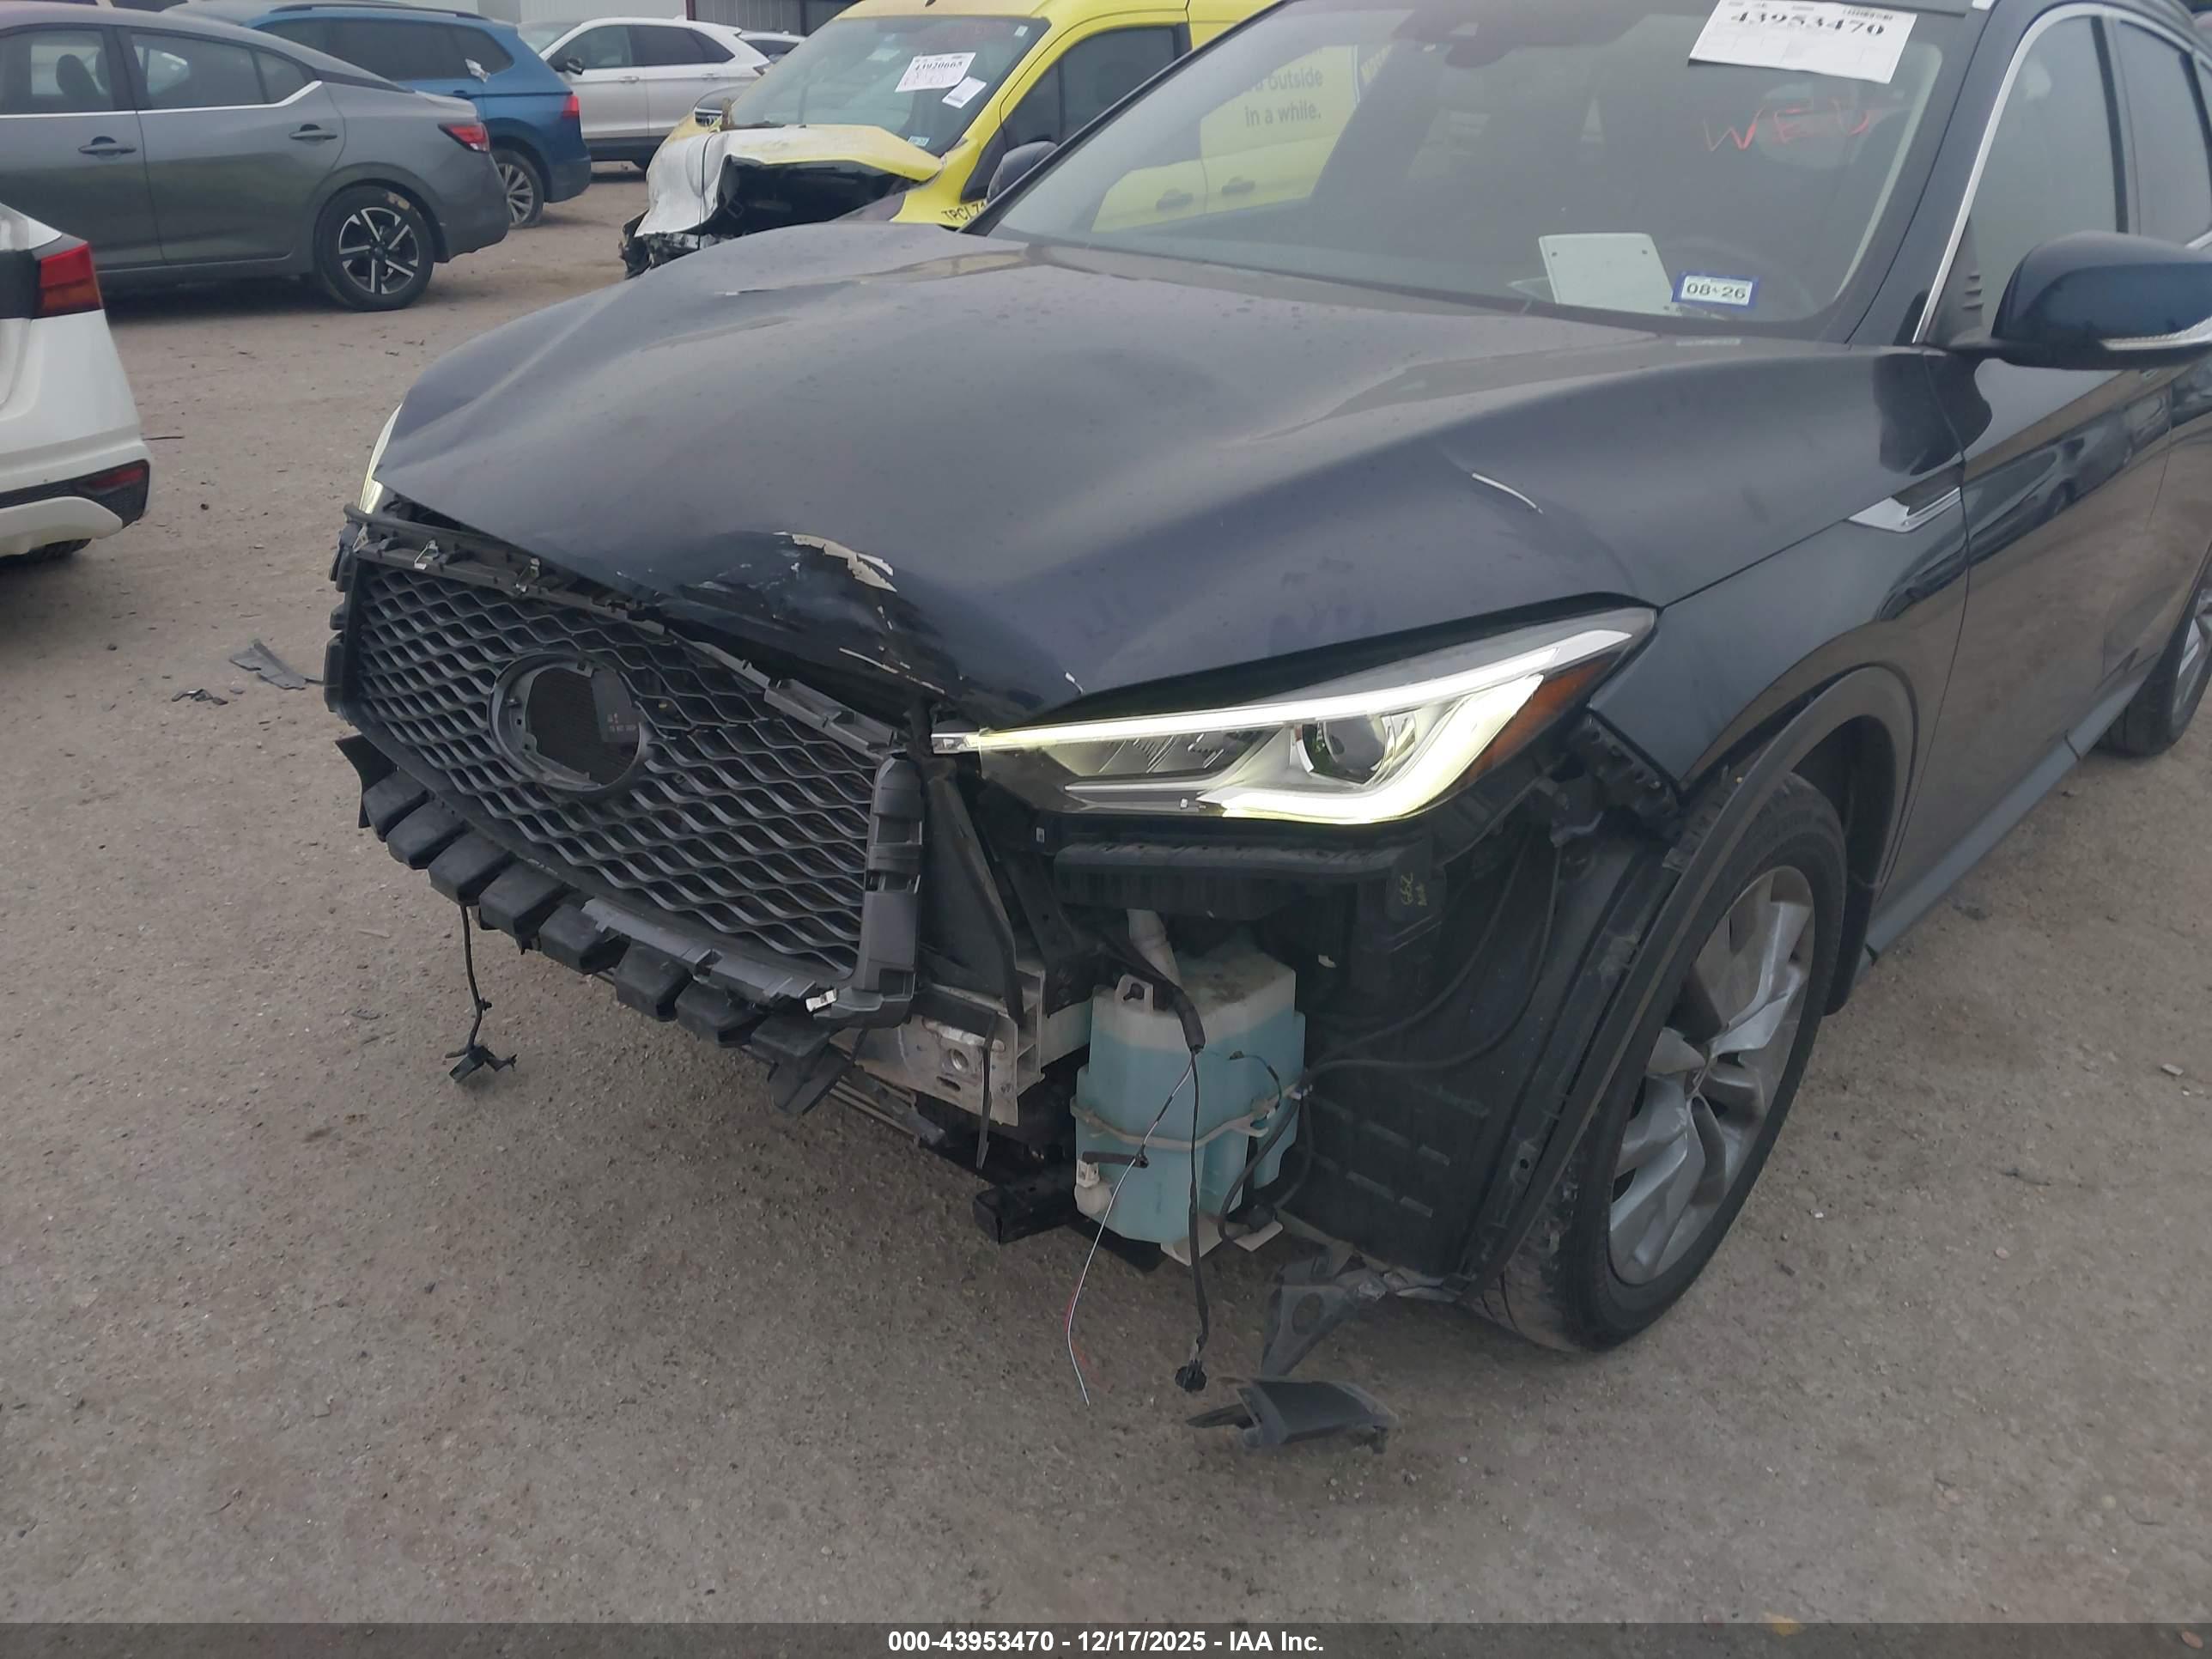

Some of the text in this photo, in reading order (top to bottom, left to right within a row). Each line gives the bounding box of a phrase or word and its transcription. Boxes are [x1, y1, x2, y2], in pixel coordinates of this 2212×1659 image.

[1730, 10, 1885, 36] 43953470
[1245, 99, 1322, 127] in a while.
